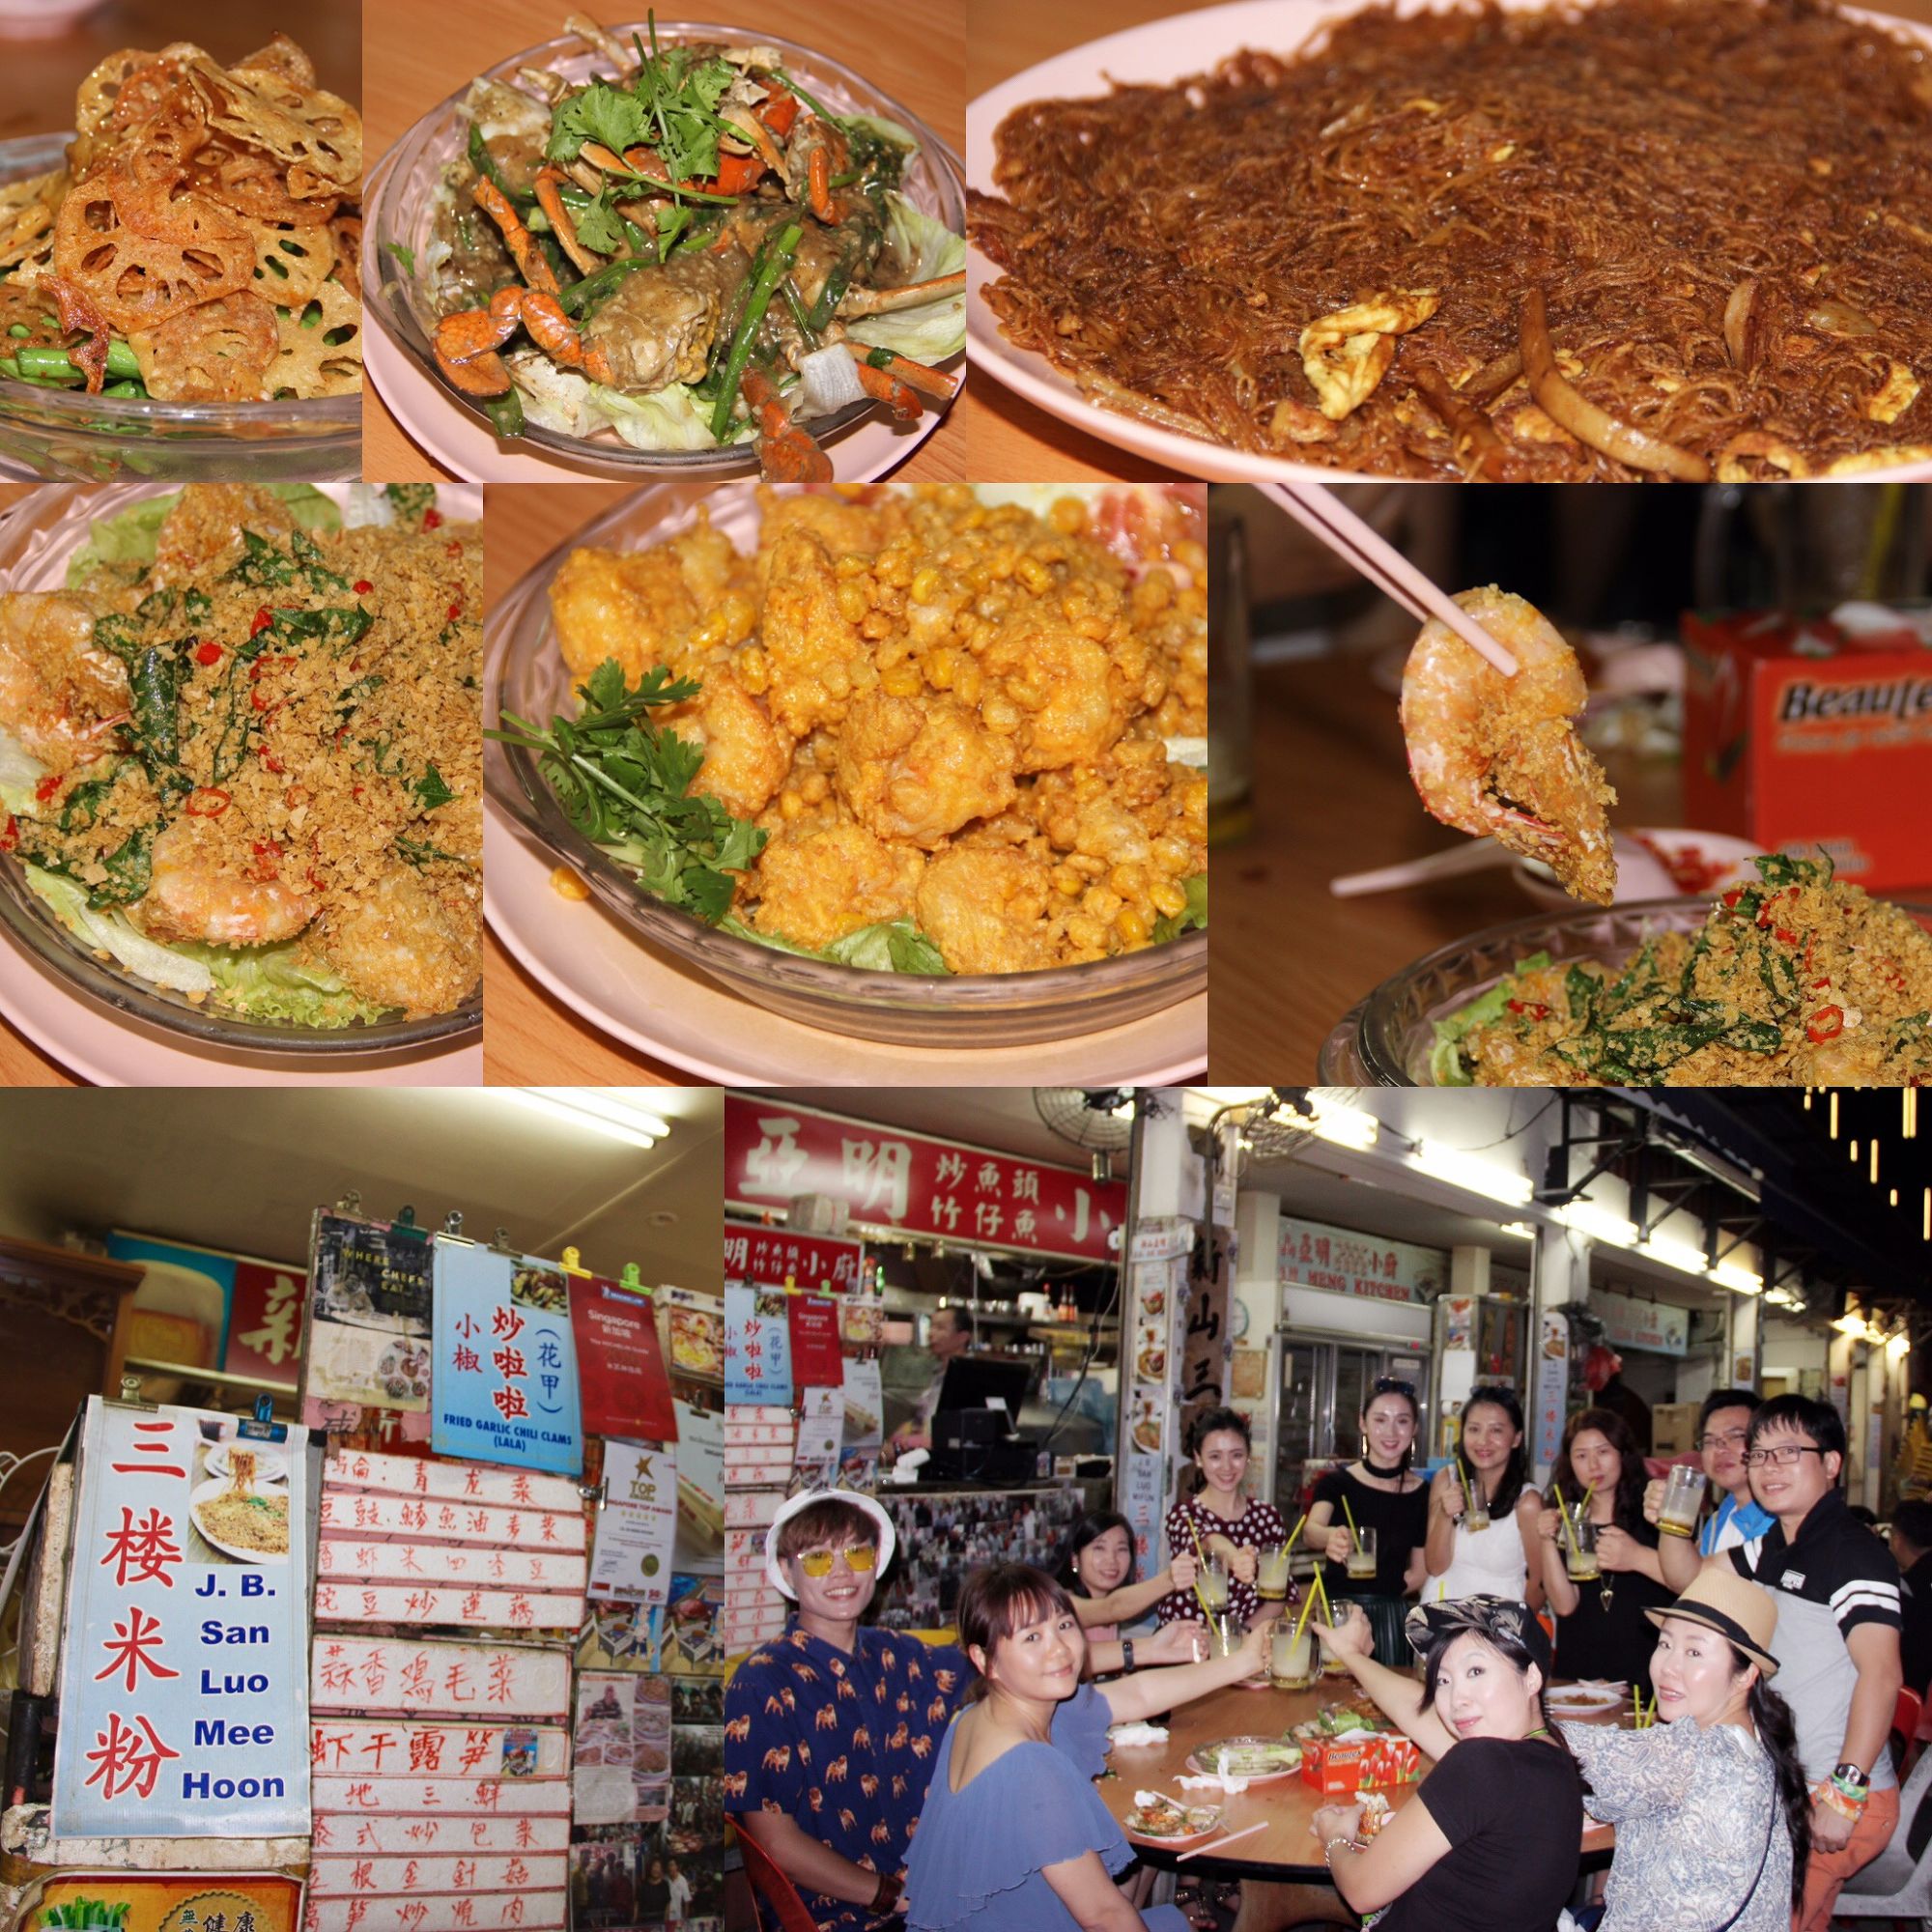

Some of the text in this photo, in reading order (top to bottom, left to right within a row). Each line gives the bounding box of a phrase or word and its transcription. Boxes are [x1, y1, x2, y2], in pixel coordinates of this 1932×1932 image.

[935, 1152, 1039, 1206] 炒魚頭
[931, 1195, 1038, 1243] 竹仔魚
[587, 1309, 641, 1329] Singapore
[491, 1306, 529, 1421] 炒啦啦
[443, 1413, 572, 1446] FRIED GARLIC CHILI CLAMS
[494, 1435, 526, 1452] (LALA)
[630, 1480, 657, 1496] TOP
[195, 1575, 276, 1598] J. B.
[84, 1422, 186, 1801] 三楼米粉
[200, 1621, 270, 1645] San
[201, 1669, 270, 1694] Luo
[194, 1720, 274, 1747] Mee
[183, 1773, 285, 1801] Hoon
